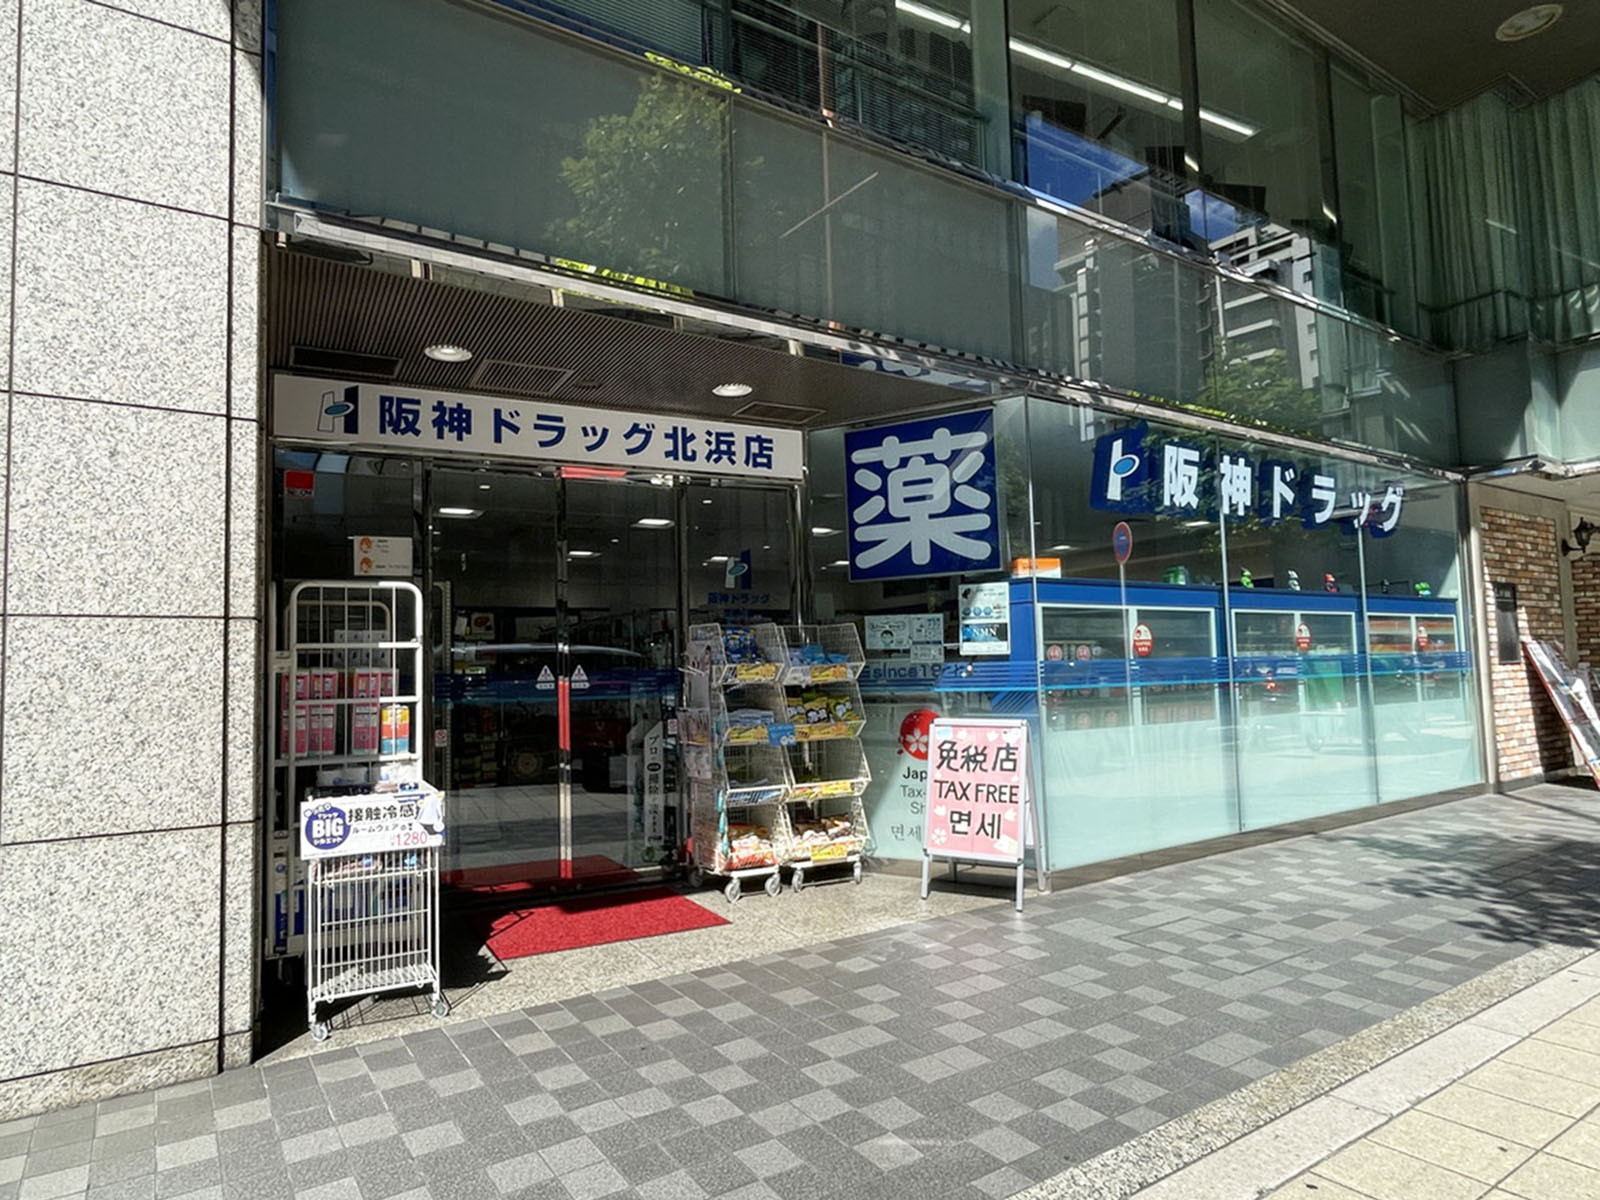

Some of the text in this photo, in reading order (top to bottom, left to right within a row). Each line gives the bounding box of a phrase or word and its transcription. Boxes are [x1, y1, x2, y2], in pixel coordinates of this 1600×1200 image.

[379, 395, 775, 470] 阪神ドラッグ北浜店
[851, 427, 992, 569] 薬
[1163, 444, 1404, 532] 阪神ドラッグ
[873, 662, 918, 679] since
[936, 740, 1019, 773] 免税店
[933, 779, 1020, 805] TAX FREE
[312, 817, 344, 839] BIG
[347, 803, 415, 823] 接触冷感
[949, 810, 1002, 841] 면세
